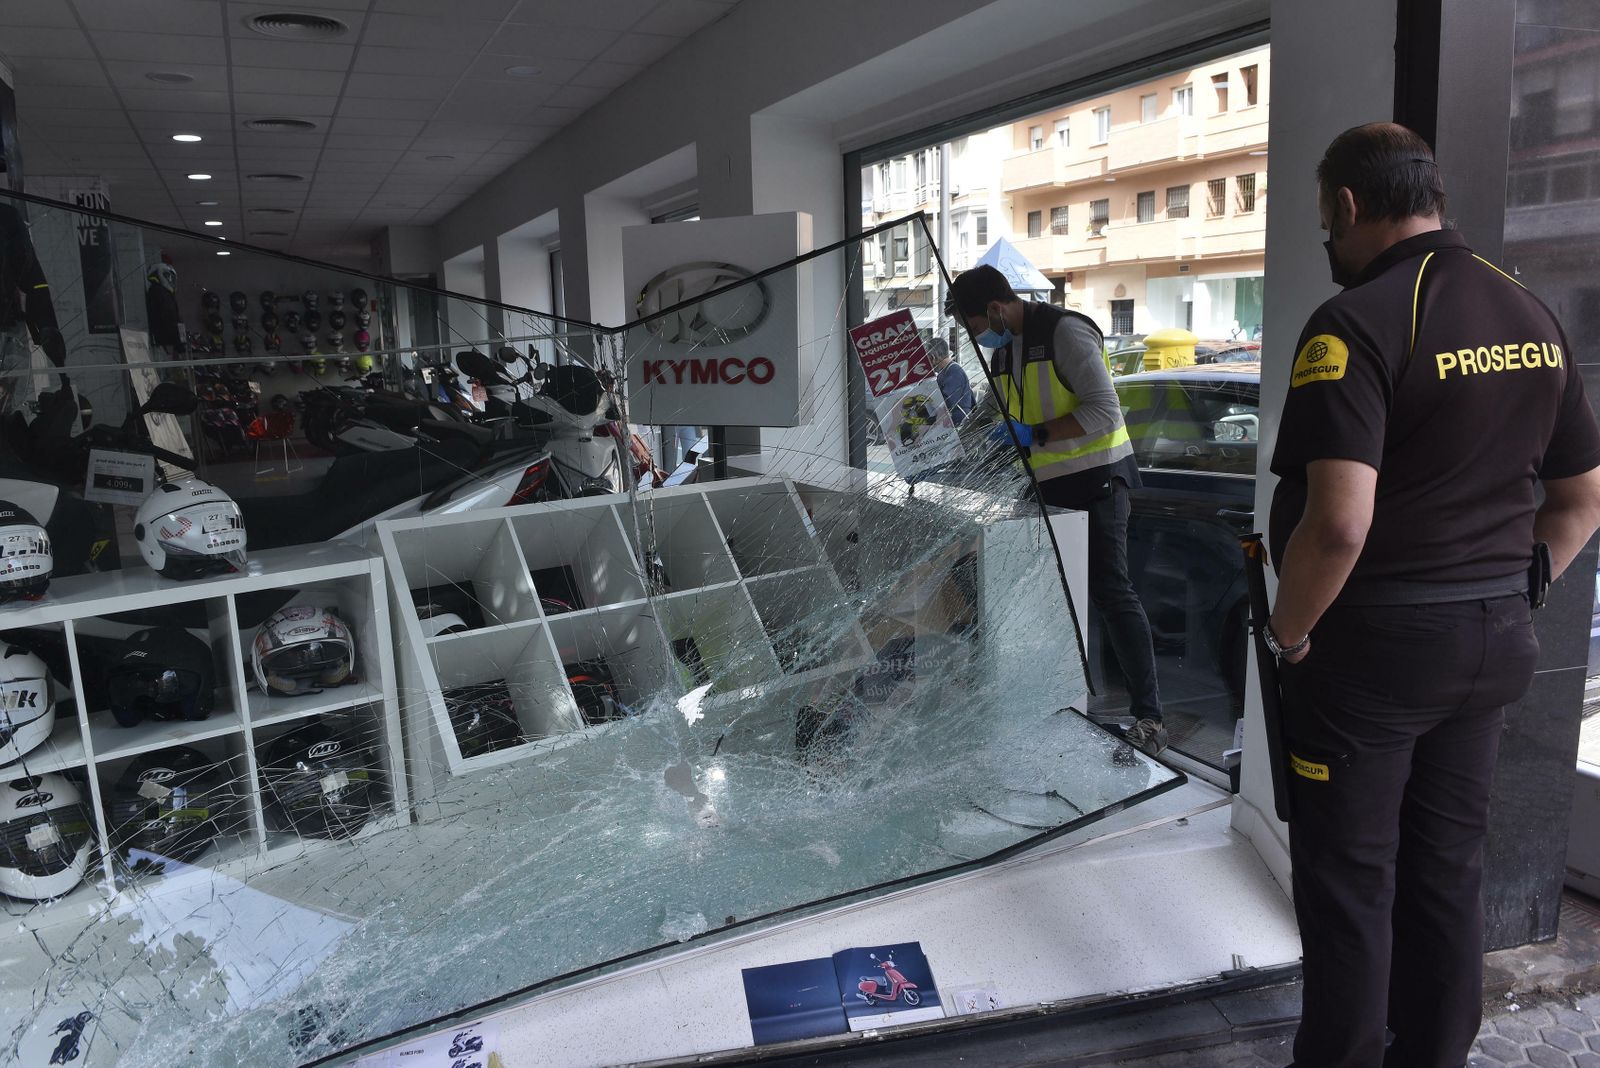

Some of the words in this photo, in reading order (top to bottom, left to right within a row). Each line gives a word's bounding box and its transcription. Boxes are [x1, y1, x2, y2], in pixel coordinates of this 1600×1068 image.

[78, 229, 99, 246] VE
[856, 320, 914, 349] GRAN
[865, 351, 898, 368] CASCOS
[643, 356, 775, 385] KYMCO
[869, 359, 910, 392] 27
[1295, 365, 1340, 380] PROSEGUR
[207, 513, 219, 521] 27
[8, 535, 21, 543] 27
